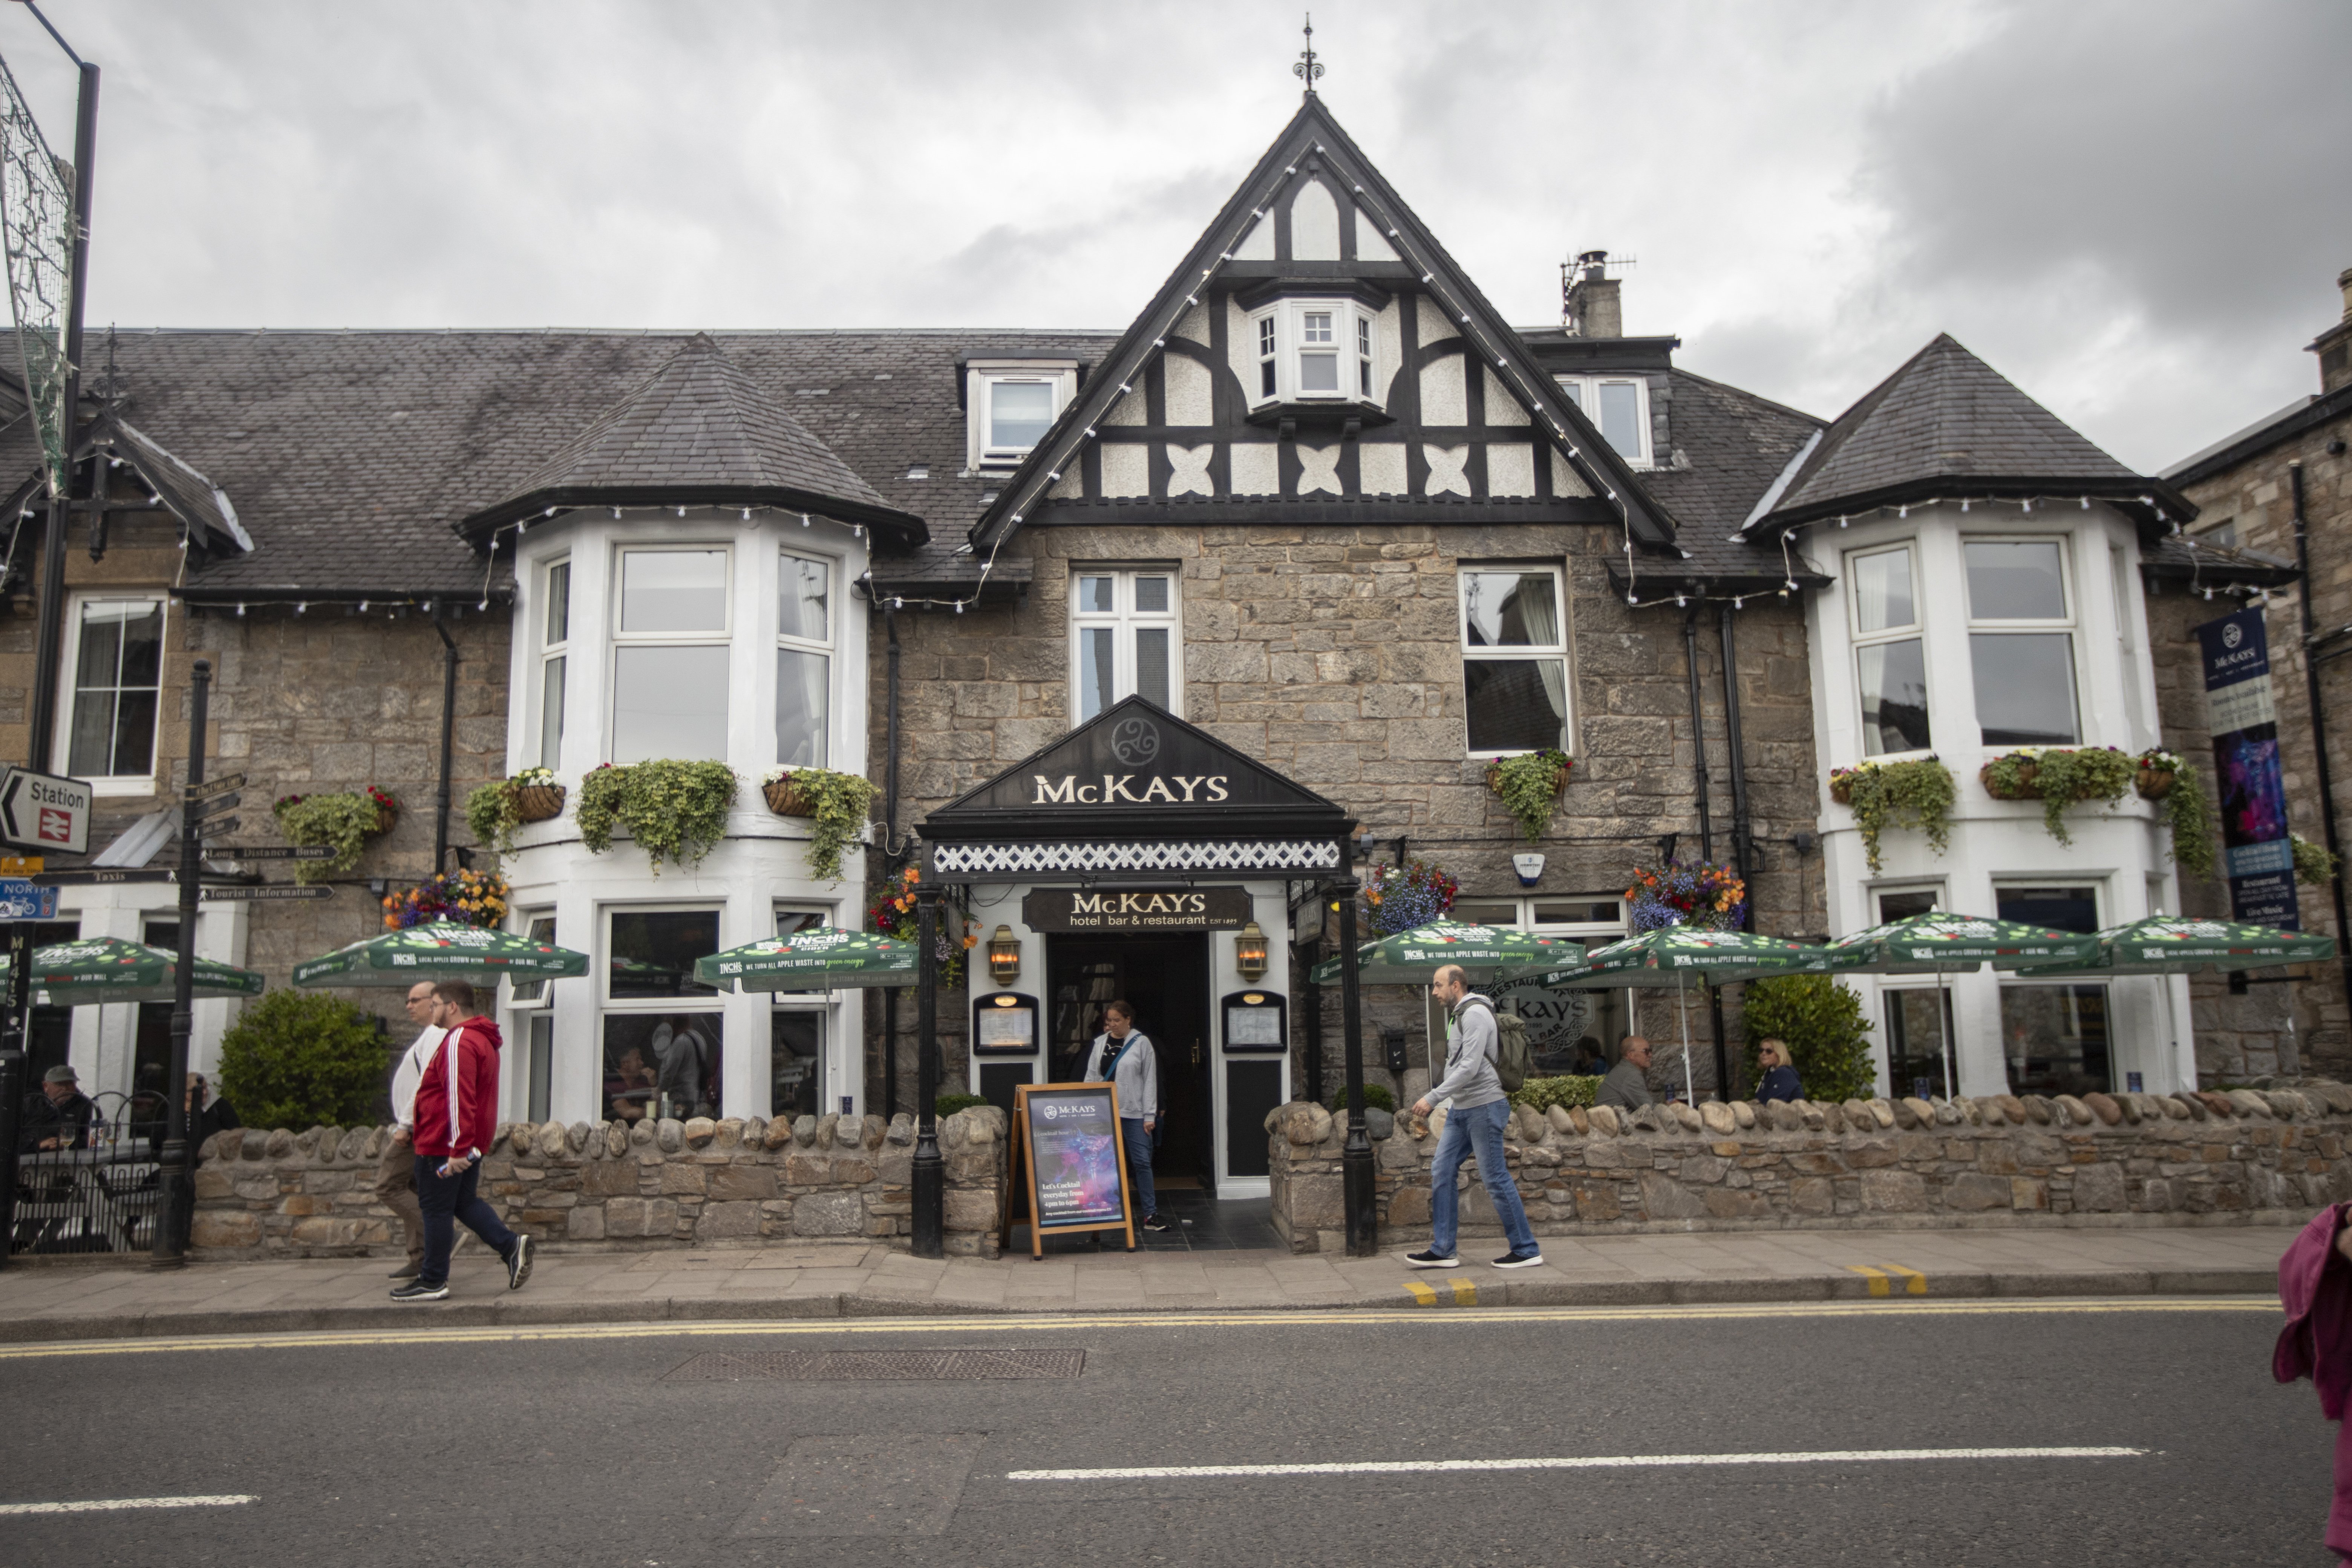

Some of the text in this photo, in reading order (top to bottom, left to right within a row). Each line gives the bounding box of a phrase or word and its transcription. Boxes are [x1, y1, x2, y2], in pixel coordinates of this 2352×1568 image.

[31, 781, 84, 808] Station
[1032, 775, 1228, 804] McKAYS
[208, 848, 324, 859] Long Distance Buses
[94, 872, 126, 882] Taxis
[211, 888, 316, 898] Tourist Information
[1071, 893, 1206, 913] McKAYS
[1070, 916, 1100, 926] hotel
[1109, 916, 1128, 925] bar
[1132, 916, 1139, 925] &
[1144, 915, 1206, 925] restaurant
[1500, 952, 1515, 961] green
[1516, 952, 1534, 962] energy
[826, 960, 843, 969] green
[844, 959, 865, 968] energy
[1539, 1023, 1563, 1041] BAR
[1059, 1106, 1095, 1114] McKAYS
